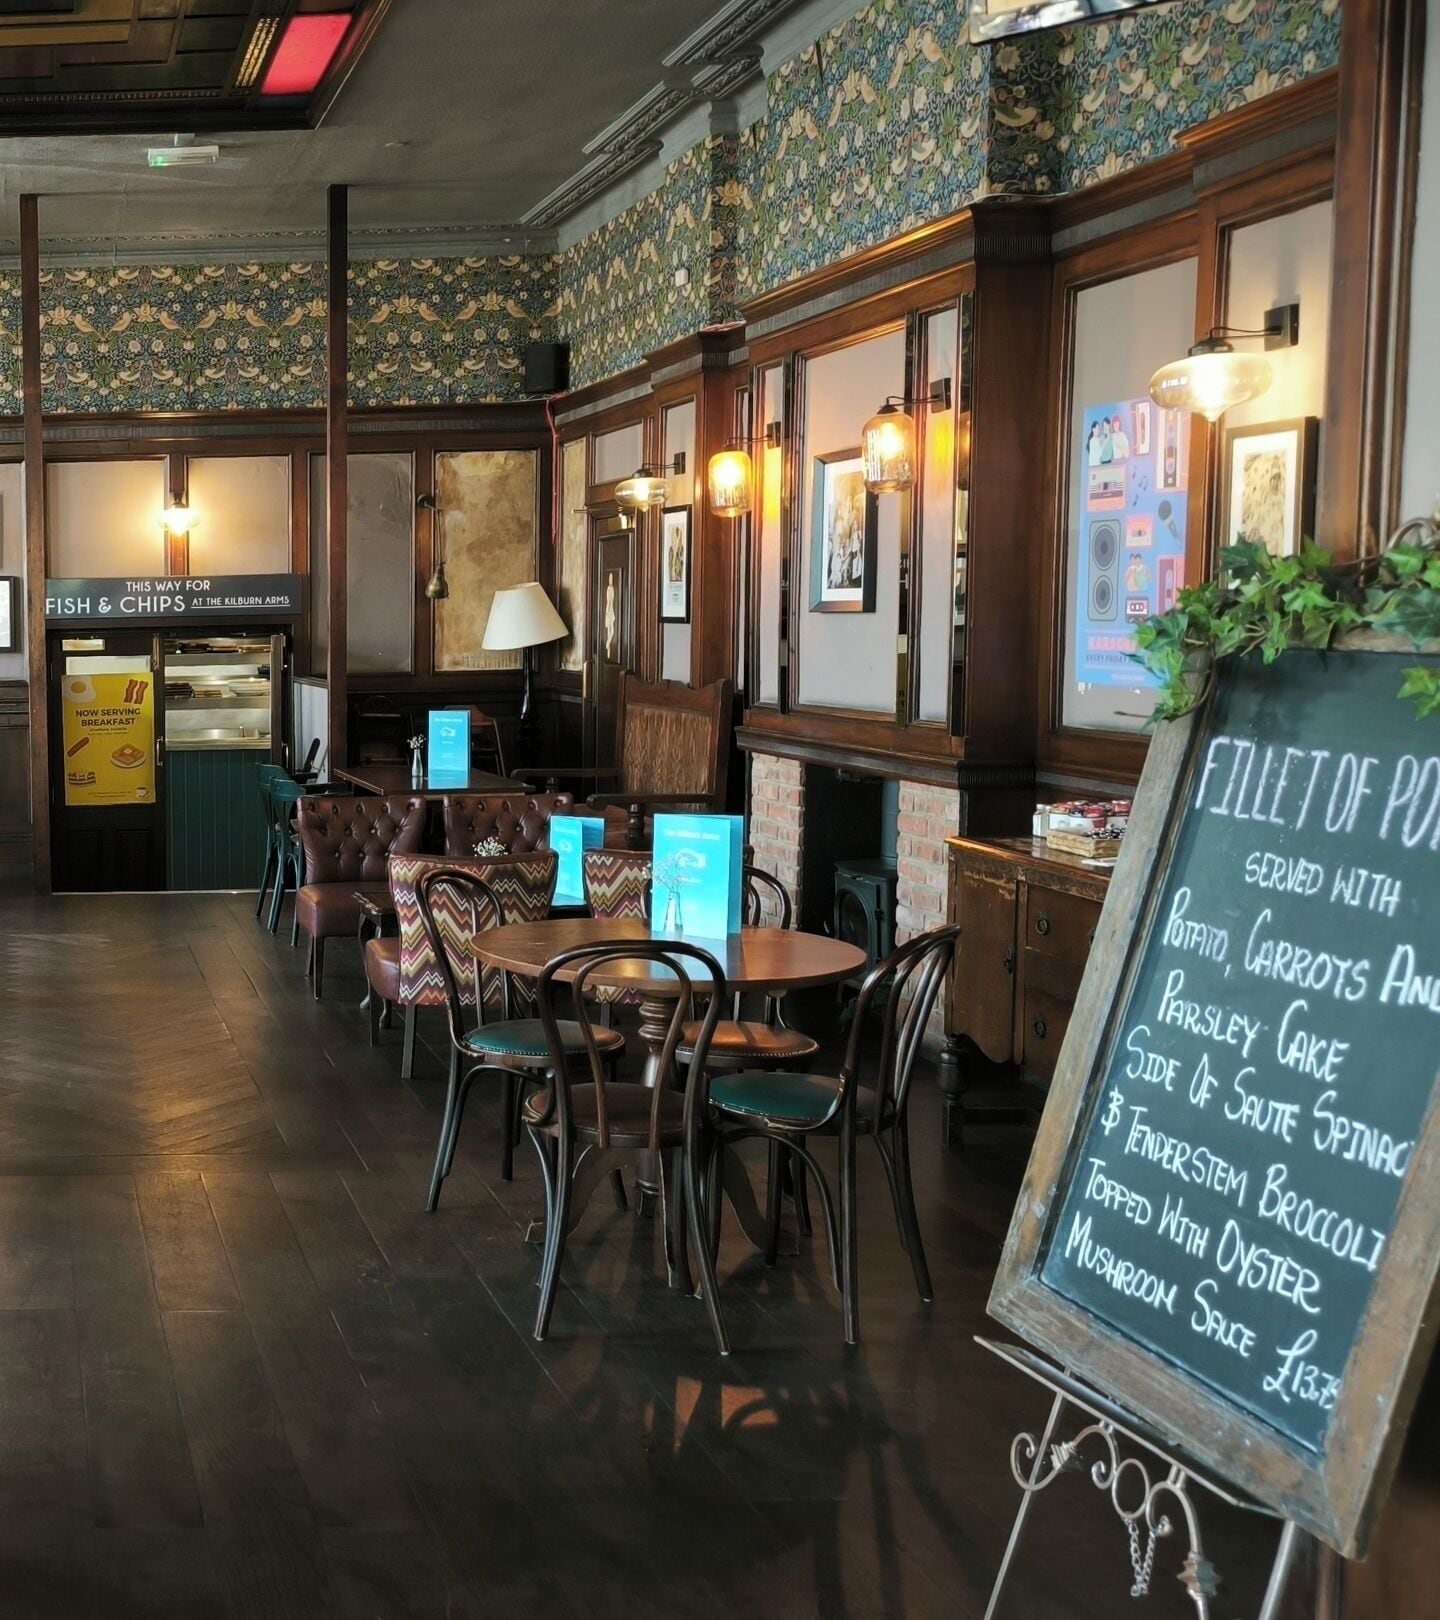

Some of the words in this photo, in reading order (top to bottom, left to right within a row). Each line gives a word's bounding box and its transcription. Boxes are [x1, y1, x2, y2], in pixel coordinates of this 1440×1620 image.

[126, 581, 151, 592] THIS
[155, 580, 181, 592] WAY
[186, 580, 210, 591] FOR
[45, 597, 90, 615] FISH
[98, 596, 112, 613] &
[120, 595, 185, 613] CHIPS
[192, 598, 203, 606] AT
[206, 597, 221, 605] THE
[224, 596, 262, 606] KILBURN
[264, 595, 290, 605] ARMS
[75, 709, 99, 717] NOW
[101, 708, 141, 716] SERVING
[81, 717, 136, 727] BREAKFAST
[1245, 851, 1325, 896] SERVED
[1329, 864, 1402, 918] WITH
[1313, 1090, 1415, 1178] SPINAC
